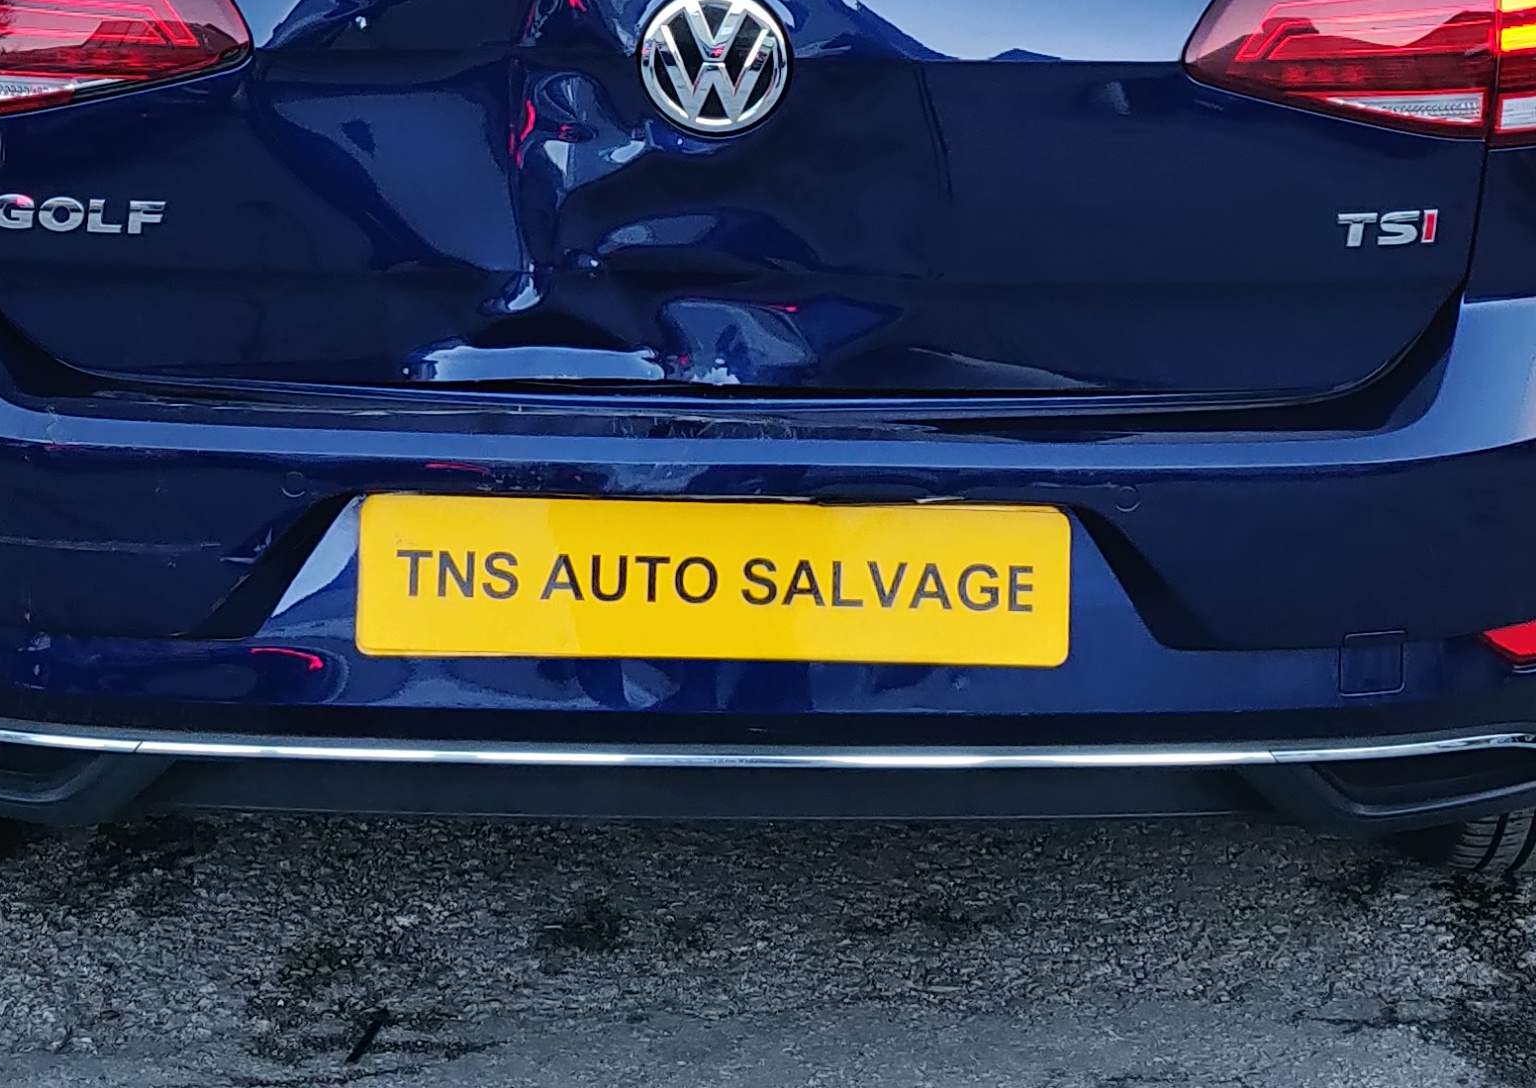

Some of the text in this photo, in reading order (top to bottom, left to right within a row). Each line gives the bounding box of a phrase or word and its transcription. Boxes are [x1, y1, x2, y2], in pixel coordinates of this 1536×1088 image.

[1337, 209, 1439, 247] TSI
[396, 549, 1034, 612] TNS AUTO SALVAGE
